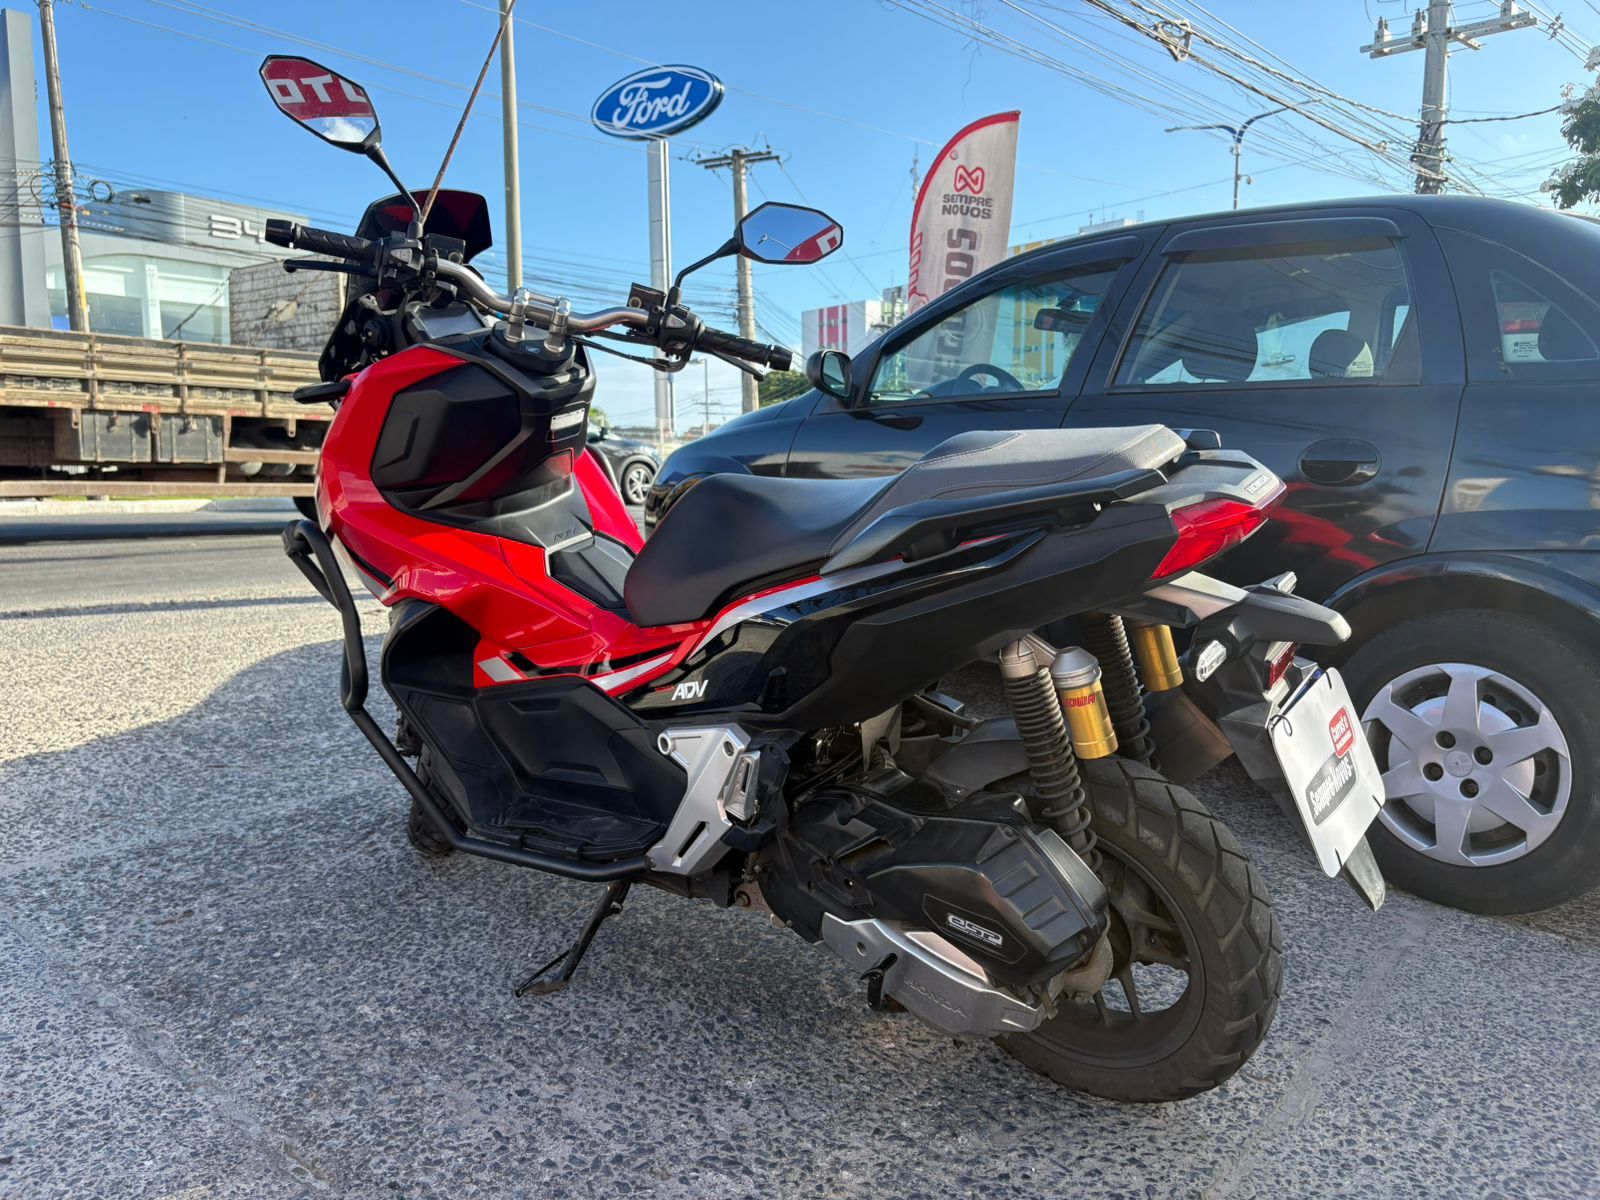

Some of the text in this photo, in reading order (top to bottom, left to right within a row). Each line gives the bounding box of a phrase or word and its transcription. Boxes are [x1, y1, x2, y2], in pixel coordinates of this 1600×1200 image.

[612, 76, 692, 129] Ford
[942, 193, 993, 208] SEMPRE
[671, 679, 709, 701] ADV
